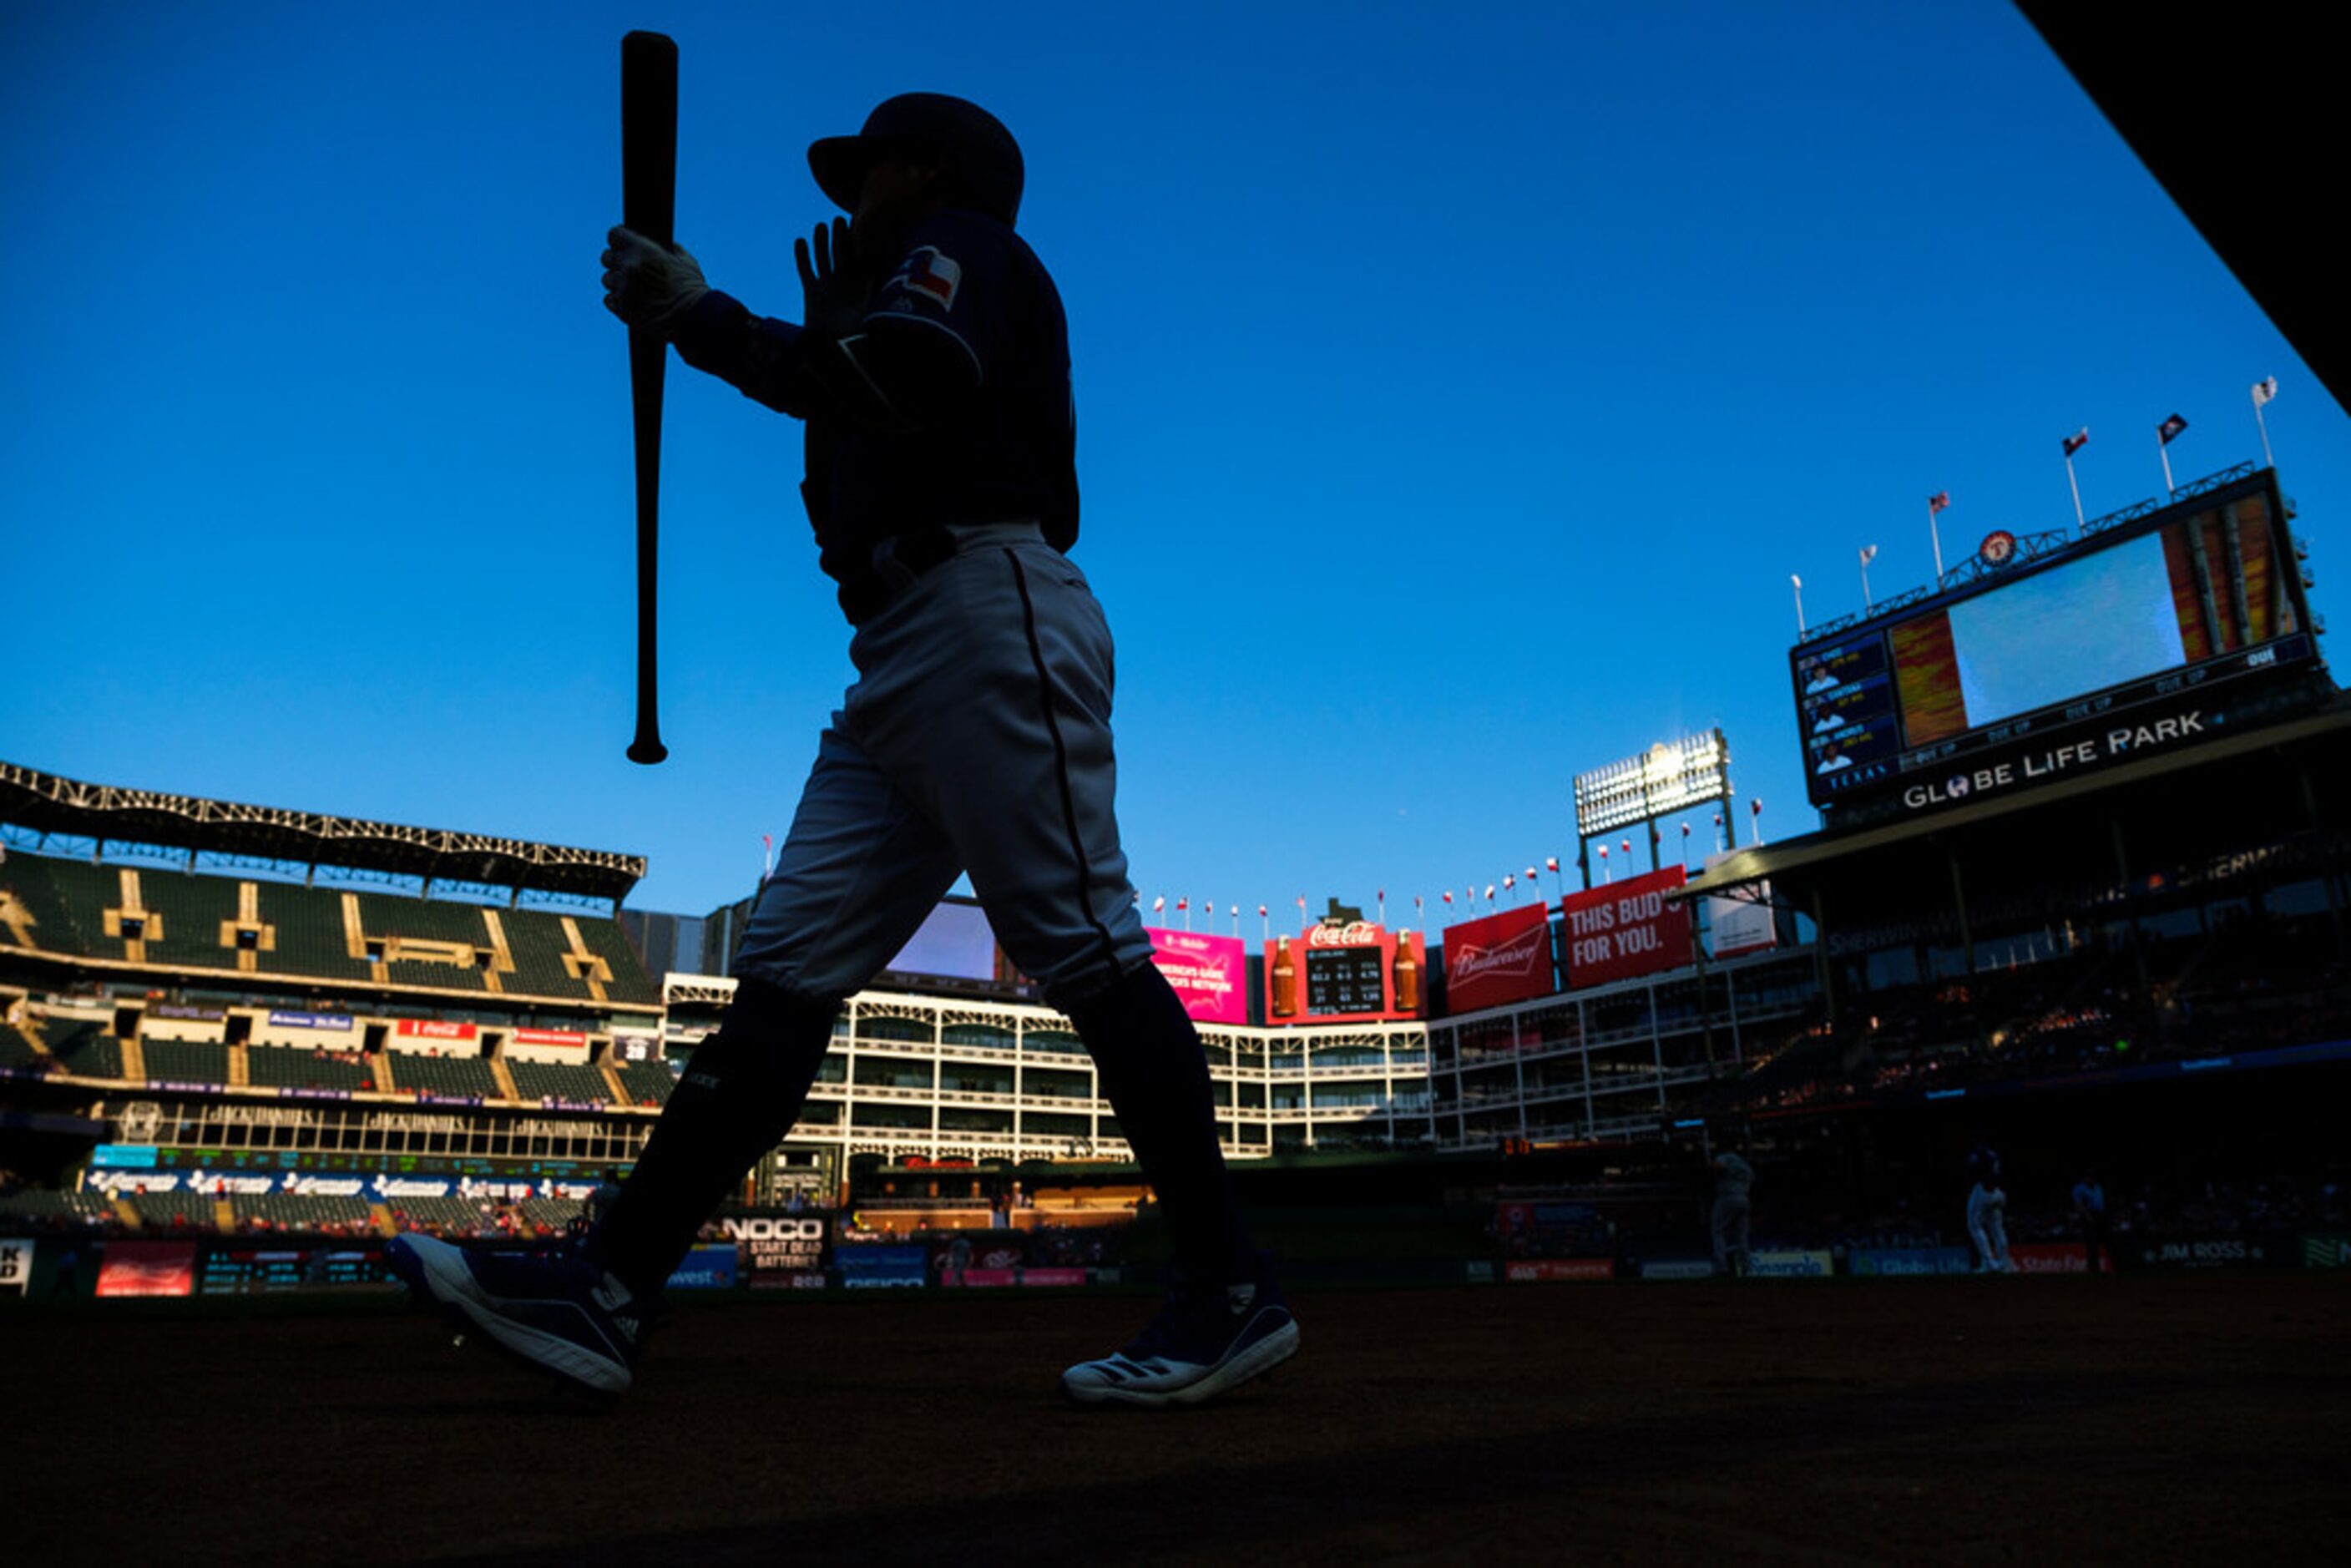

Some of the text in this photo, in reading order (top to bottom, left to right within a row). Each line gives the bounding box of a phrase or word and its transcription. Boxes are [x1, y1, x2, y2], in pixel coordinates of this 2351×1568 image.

[1904, 711, 2205, 809] GLOBE LIFE PARK
[1309, 922, 1376, 947] Coca-Cola
[1569, 904, 1615, 937] THIS
[1455, 945, 1534, 977] Budweiser
[1572, 925, 1663, 967] FOR YOU.
[722, 1217, 823, 1241] NOCO
[2192, 1240, 2246, 1259] ROSS
